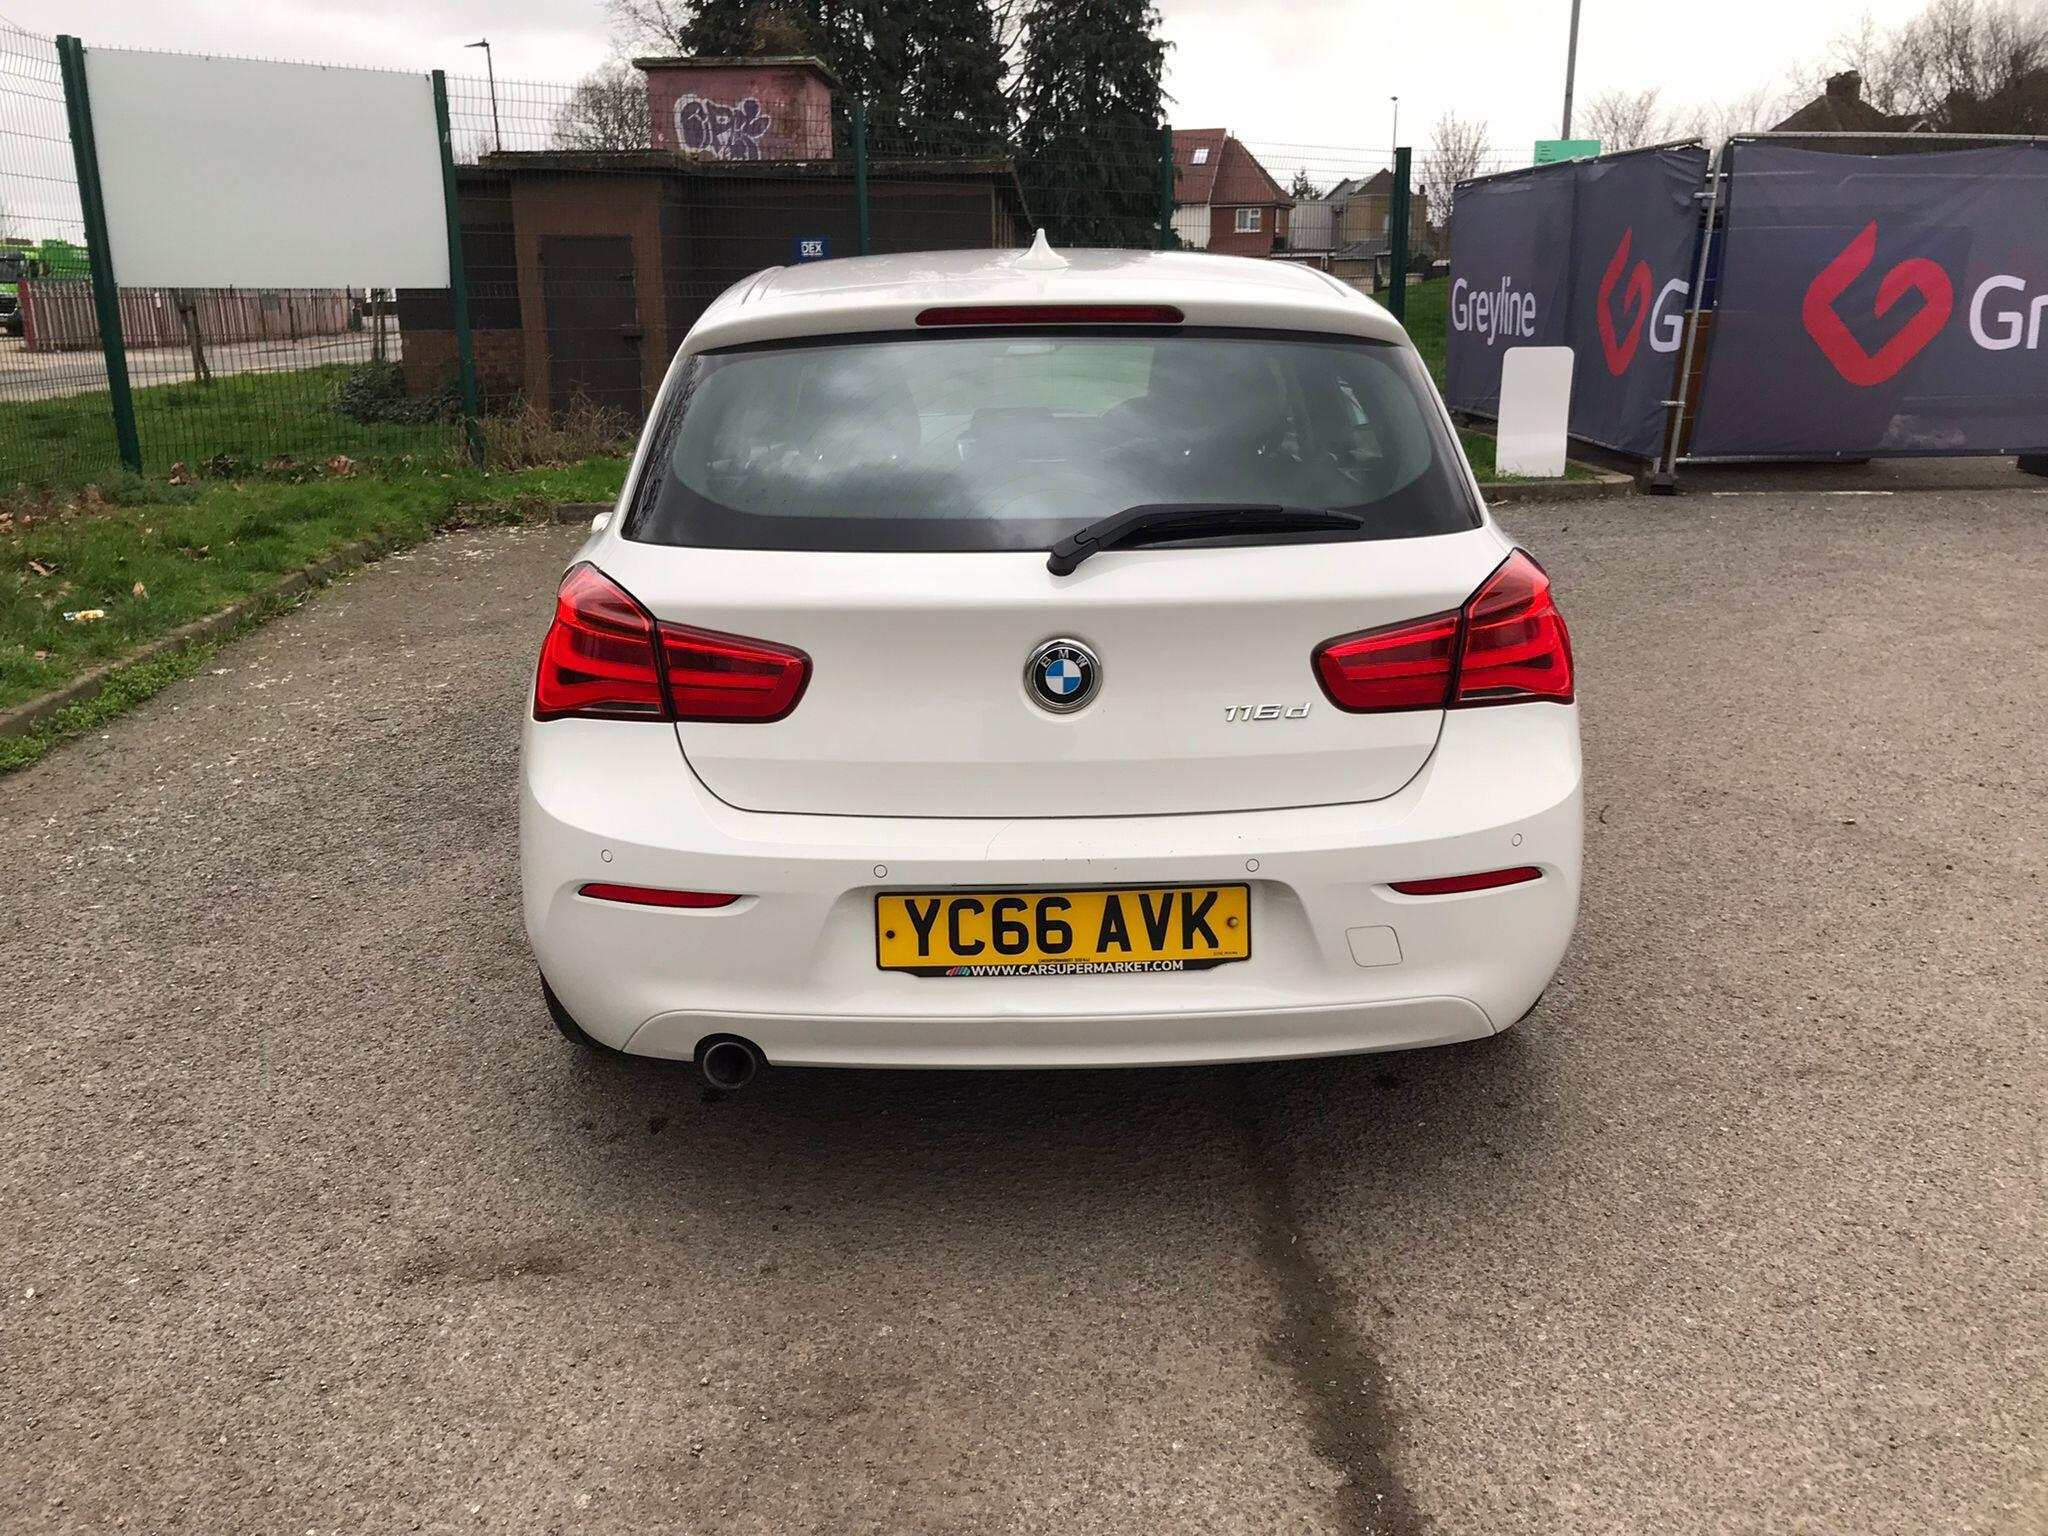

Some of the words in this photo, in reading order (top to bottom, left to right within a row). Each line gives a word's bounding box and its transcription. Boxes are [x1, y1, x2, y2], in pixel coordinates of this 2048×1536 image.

[800, 242, 823, 254] DEX
[1451, 275, 1536, 346] Greyline
[1040, 649, 1088, 668] BMW
[1224, 702, 1311, 722] 116d
[904, 896, 1073, 957] YC66
[1096, 891, 1219, 953] AVK
[971, 959, 1184, 976] WWW.CARSUPERMARKET.COM
